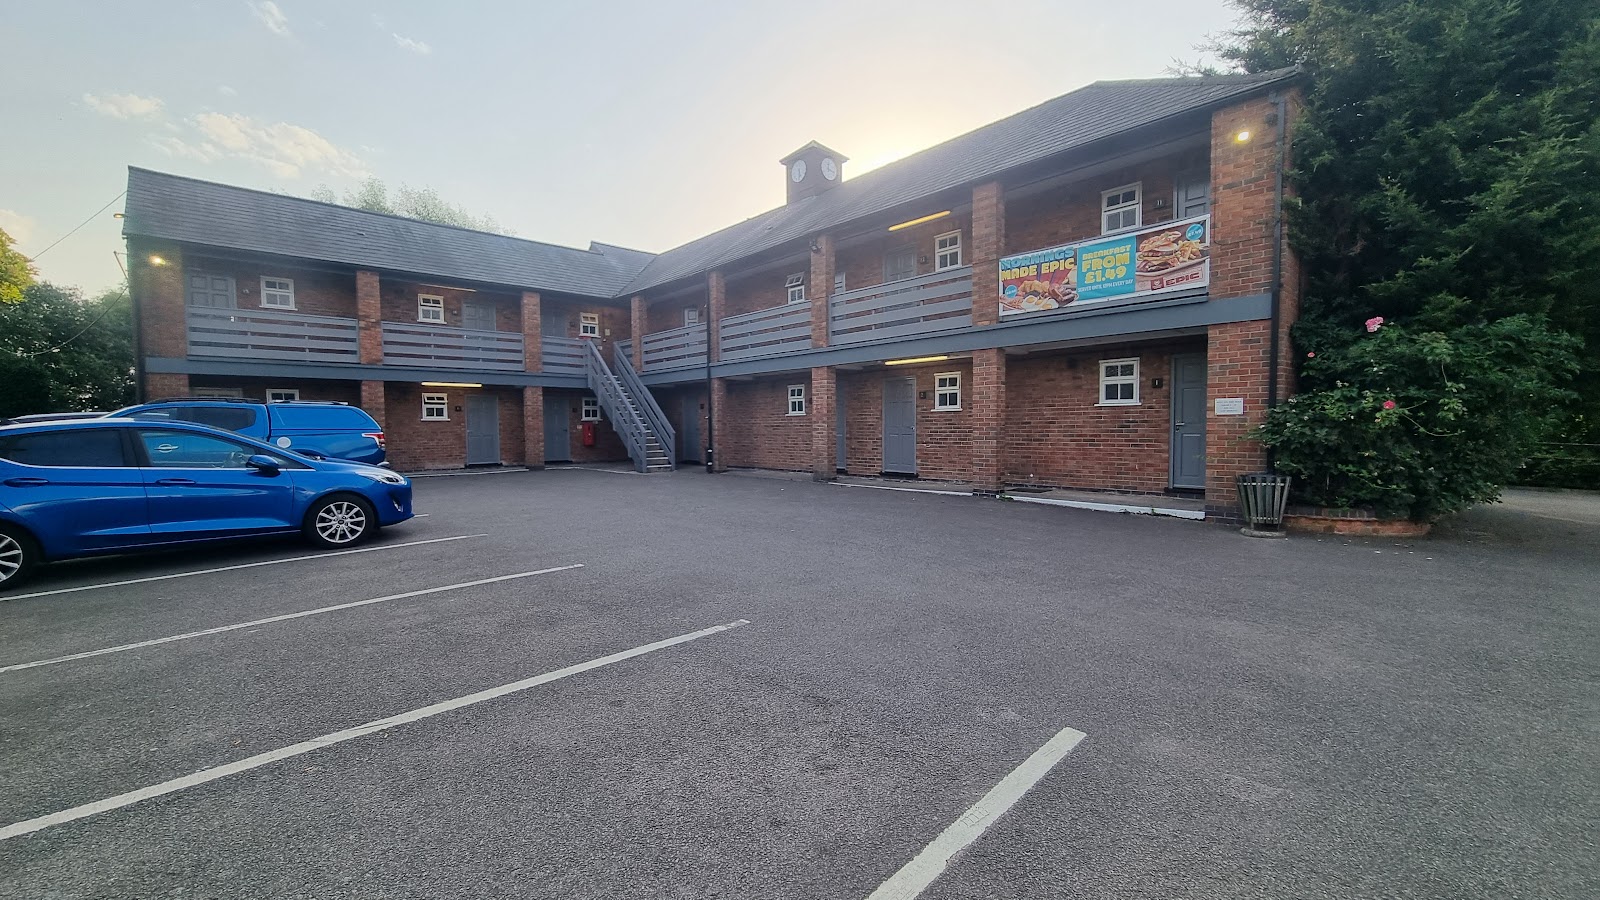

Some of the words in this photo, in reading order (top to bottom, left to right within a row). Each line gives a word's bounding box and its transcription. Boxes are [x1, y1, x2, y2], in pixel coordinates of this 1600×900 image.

[1082, 245, 1131, 260] BREAKFAST
[1001, 265, 1037, 281] MADE
[1041, 258, 1075, 274] EPIC
[1082, 252, 1130, 272] FROM
[1085, 266, 1127, 284] £1.49
[1166, 272, 1200, 286] EPIC
